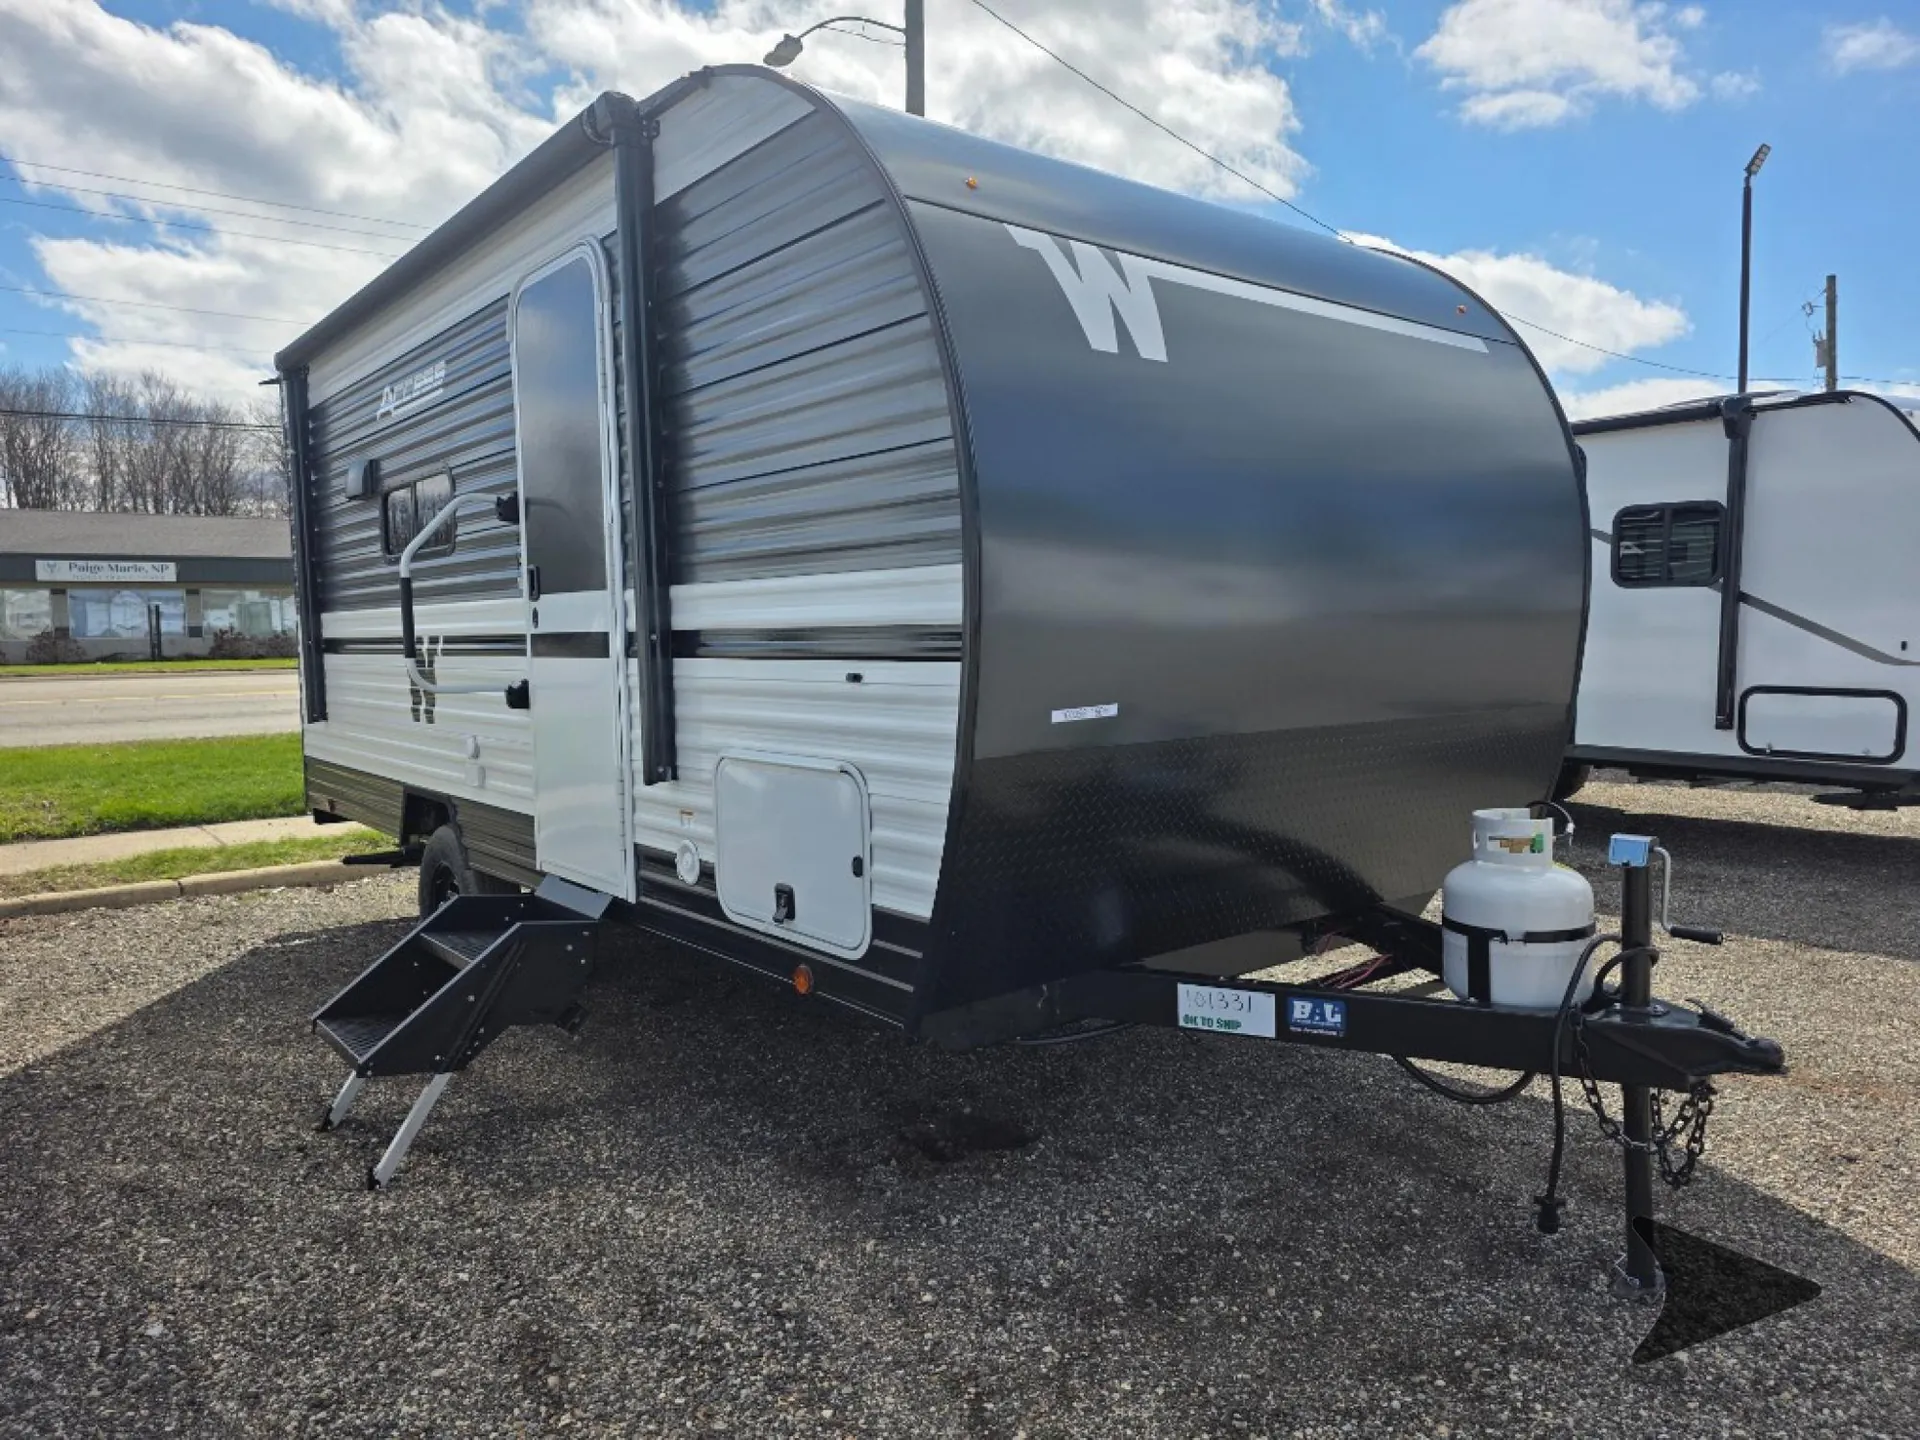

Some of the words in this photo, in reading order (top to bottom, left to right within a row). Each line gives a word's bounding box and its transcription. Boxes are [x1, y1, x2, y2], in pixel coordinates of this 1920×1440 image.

[68, 562, 103, 575] Paige
[107, 563, 149, 574] Marie,
[152, 564, 170, 574] NP
[1200, 1016, 1213, 1028] TO
[1216, 1018, 1242, 1030] SHIP
